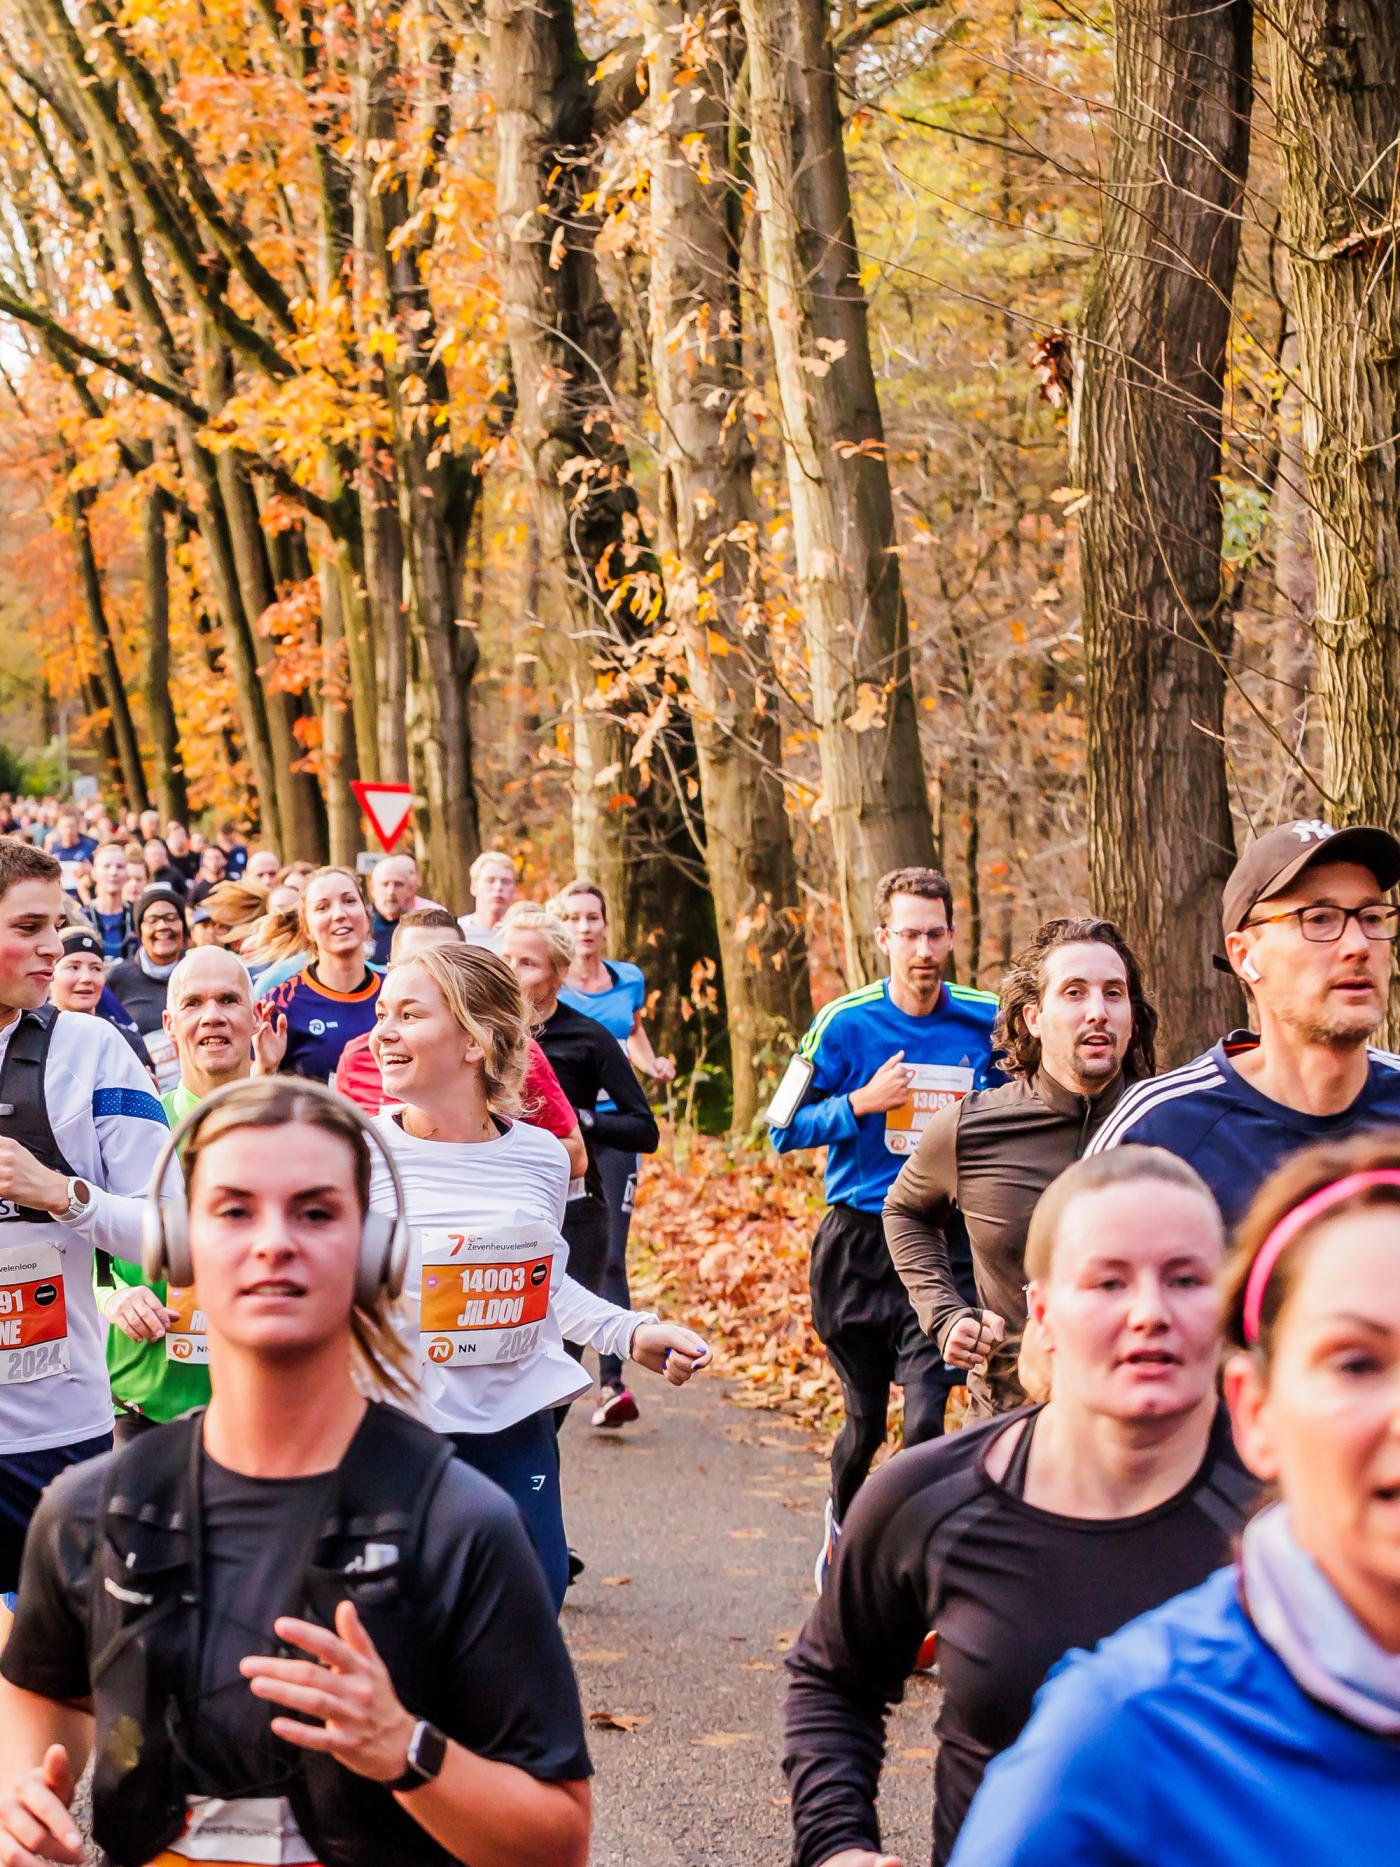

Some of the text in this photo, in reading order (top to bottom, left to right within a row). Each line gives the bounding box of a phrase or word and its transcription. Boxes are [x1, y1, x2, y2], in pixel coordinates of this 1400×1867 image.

[448, 1234, 538, 1257] 7 Zevenheuvelenloop
[460, 1267, 525, 1293] 14003
[457, 1296, 525, 1327] JILDOU
[458, 1343, 476, 1353] NN
[496, 1325, 540, 1360] 2024
[8, 1344, 61, 1379] 2024
